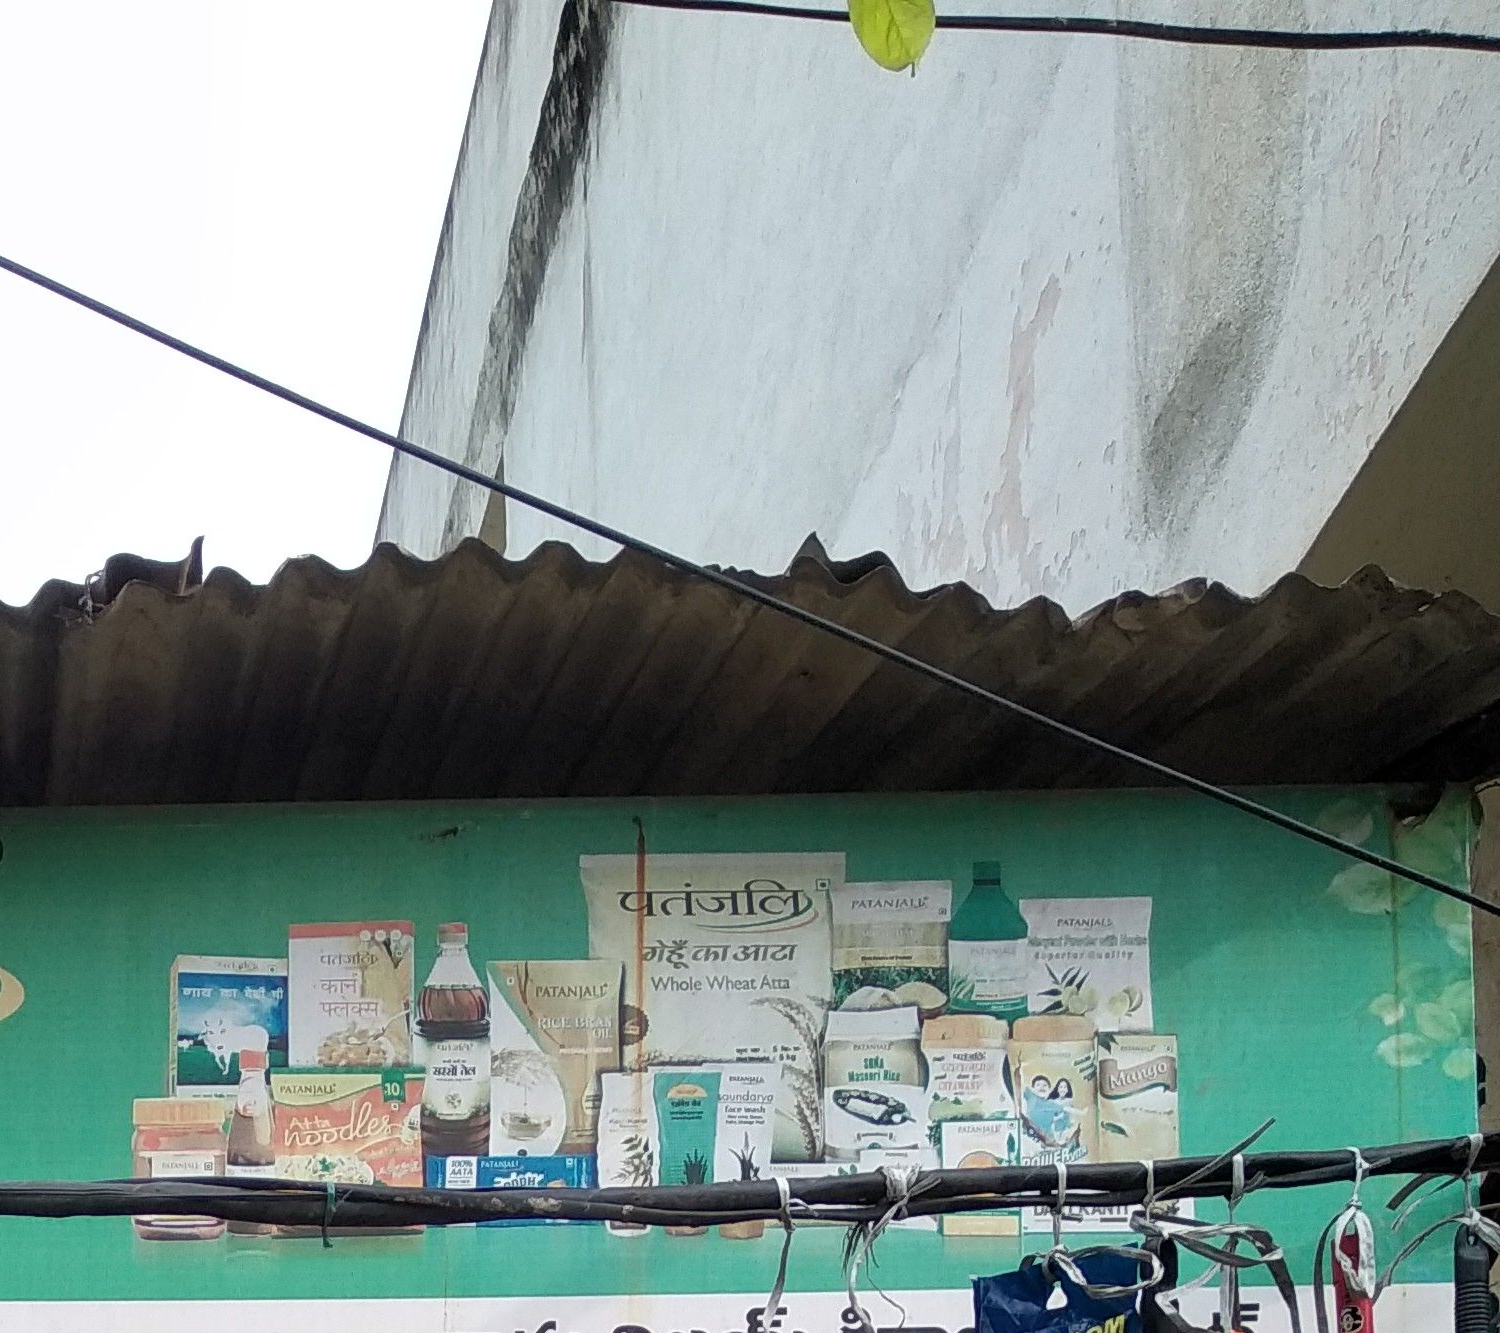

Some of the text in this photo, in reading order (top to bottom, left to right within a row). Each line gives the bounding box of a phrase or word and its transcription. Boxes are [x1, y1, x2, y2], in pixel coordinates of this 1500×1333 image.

[618, 879, 811, 922] पतंजलि
[852, 896, 929, 909] PATANJALI
[691, 941, 729, 964] का
[731, 941, 798, 963] आटा
[535, 983, 608, 1000] PATANJALI
[650, 974, 790, 993] Whole Wheat Atta
[537, 1017, 572, 1029] RICE
[592, 1028, 613, 1039] OIL
[1108, 1060, 1167, 1090] Mango
[279, 1083, 337, 1095] PATANJALI
[283, 1101, 392, 1147] noodles
[289, 1116, 331, 1130] Atta
